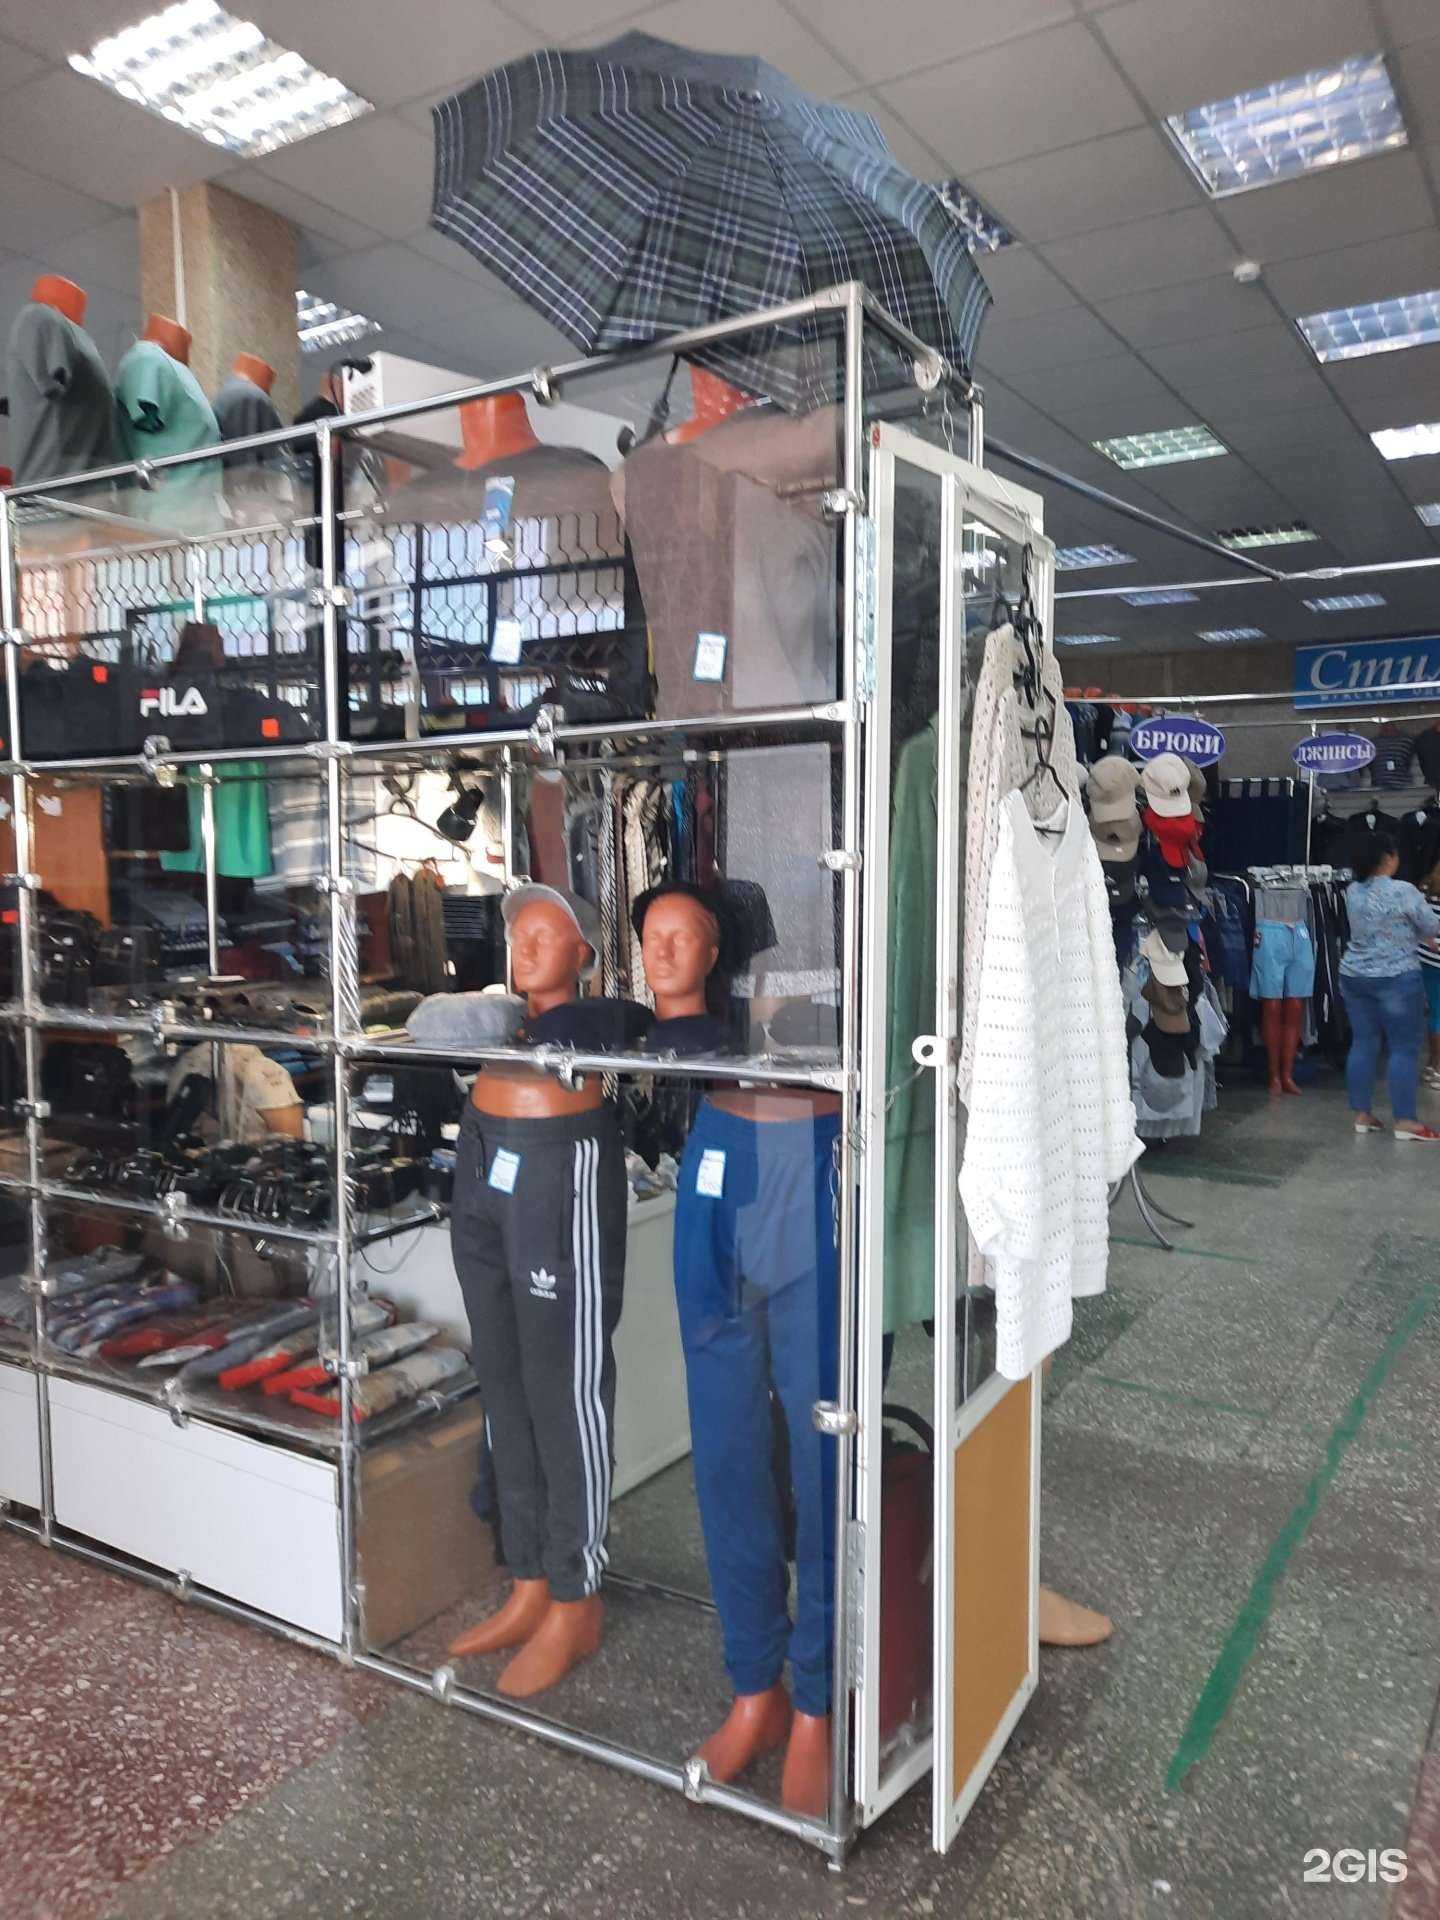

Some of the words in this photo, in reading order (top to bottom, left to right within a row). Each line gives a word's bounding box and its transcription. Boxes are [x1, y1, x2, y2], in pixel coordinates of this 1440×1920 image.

[139, 687, 208, 717] FILA
[1136, 730, 1221, 755] БРЮКИ
[1296, 744, 1371, 763] ДЖИНСЫ
